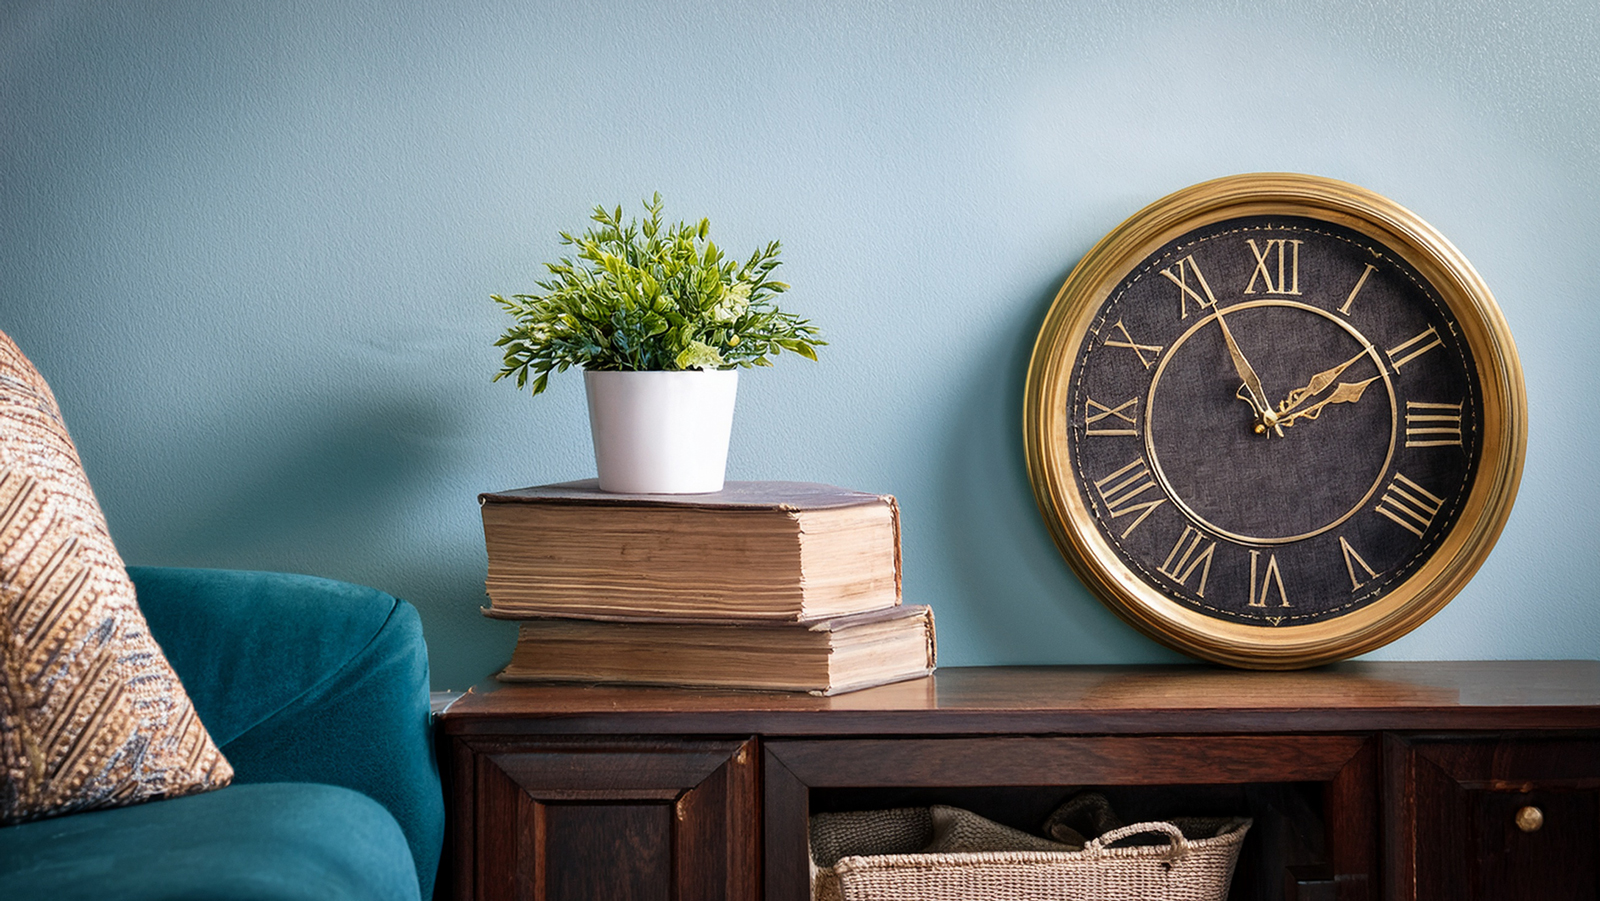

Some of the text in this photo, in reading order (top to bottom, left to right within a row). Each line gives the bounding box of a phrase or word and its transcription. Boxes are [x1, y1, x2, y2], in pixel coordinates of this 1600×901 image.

[1159, 254, 1217, 319] XI
[1244, 238, 1303, 295] XII
[1337, 262, 1379, 316] I
[1103, 318, 1163, 370] X
[1385, 323, 1446, 375] II
[1085, 395, 1140, 439] IX
[1093, 456, 1168, 540] VIII
[1375, 472, 1447, 539] IIII
[1156, 525, 1217, 598] VII
[1249, 550, 1293, 608] VI
[1339, 536, 1384, 592] V
